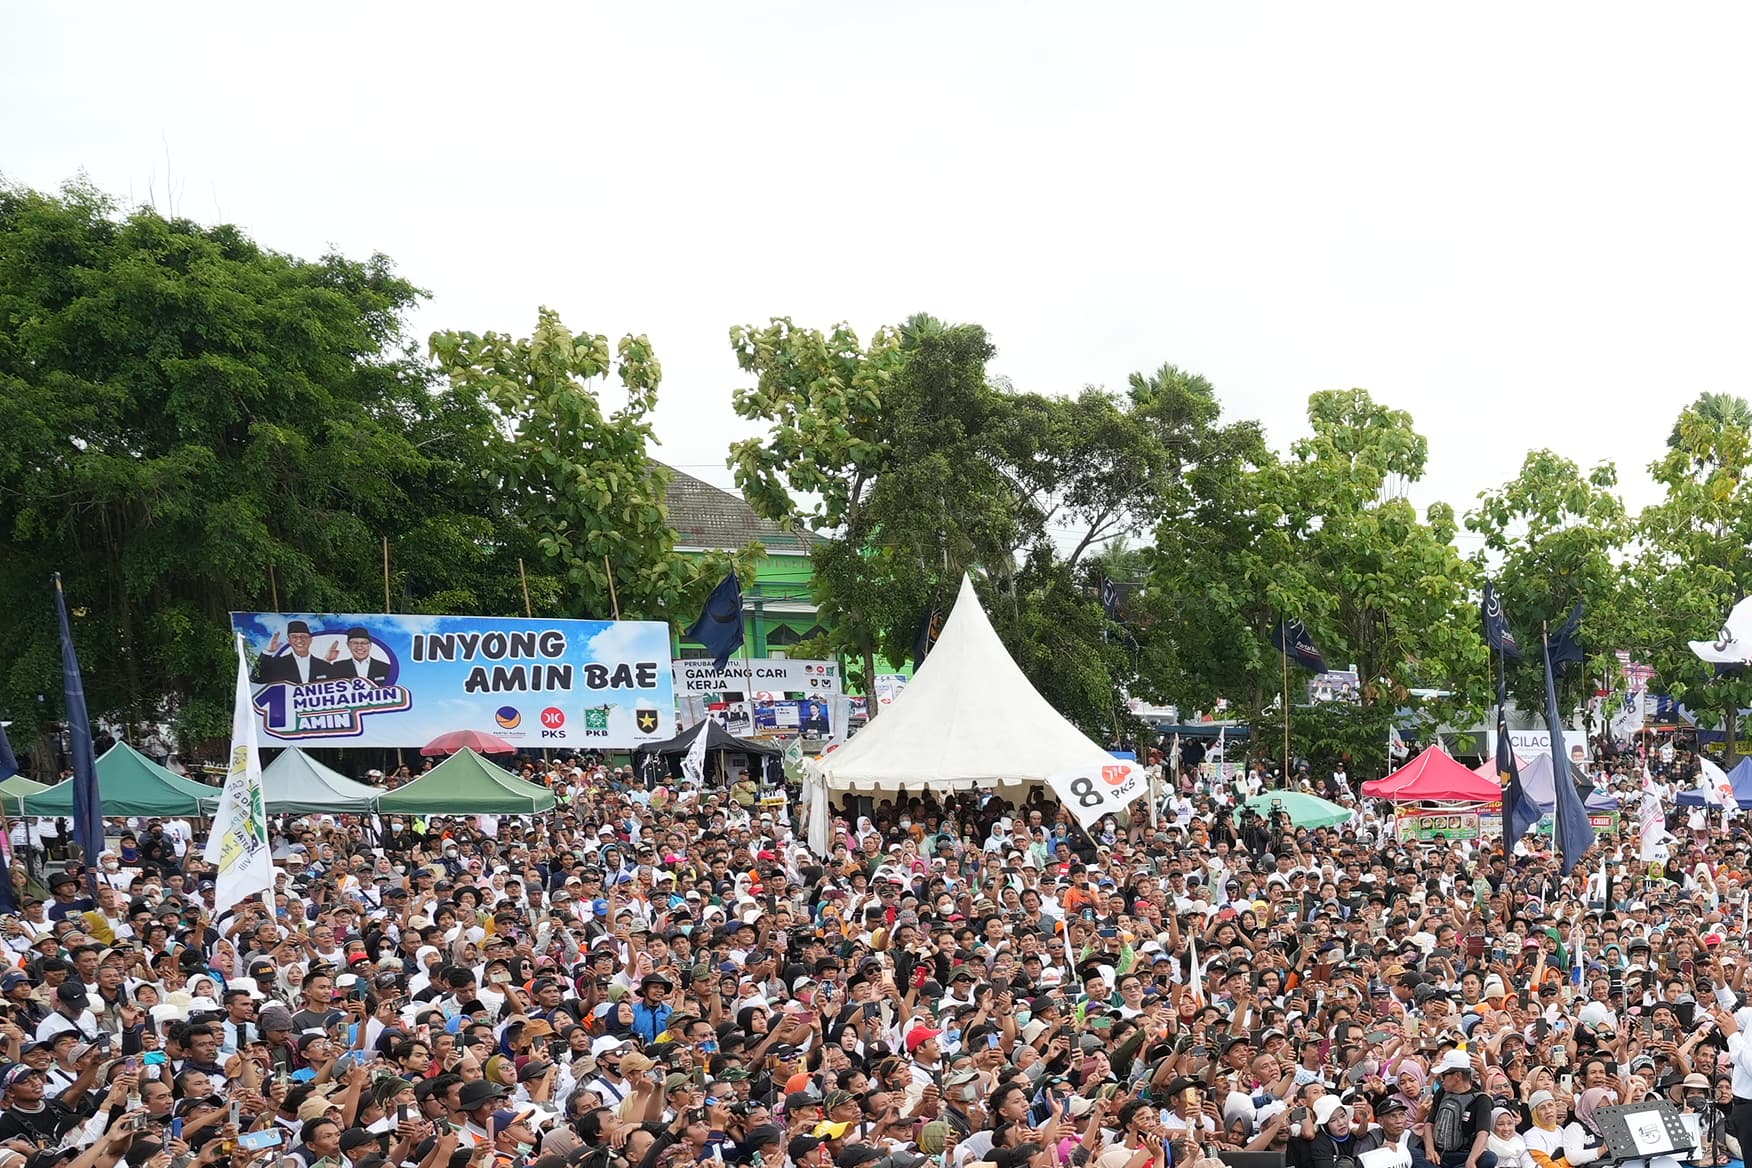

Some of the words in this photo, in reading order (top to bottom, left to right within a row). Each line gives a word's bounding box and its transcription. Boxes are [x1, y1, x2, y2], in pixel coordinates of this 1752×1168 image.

[413, 632, 565, 661] INYONG
[466, 664, 572, 693] AMIN
[584, 662, 657, 690] BAE
[686, 668, 752, 679] GAMPANG
[756, 668, 787, 678] CARI
[293, 681, 347, 698] ANIES
[352, 679, 366, 690] &
[687, 680, 727, 690] KERJA
[255, 684, 286, 728] 1
[293, 688, 397, 709] MUHAIMIN
[298, 713, 350, 729] AMIN
[541, 730, 566, 739] PKS
[586, 729, 609, 737] PKB
[1511, 736, 1552, 748] CILAC
[1070, 777, 1104, 807] 8
[1111, 777, 1136, 799] PKS
